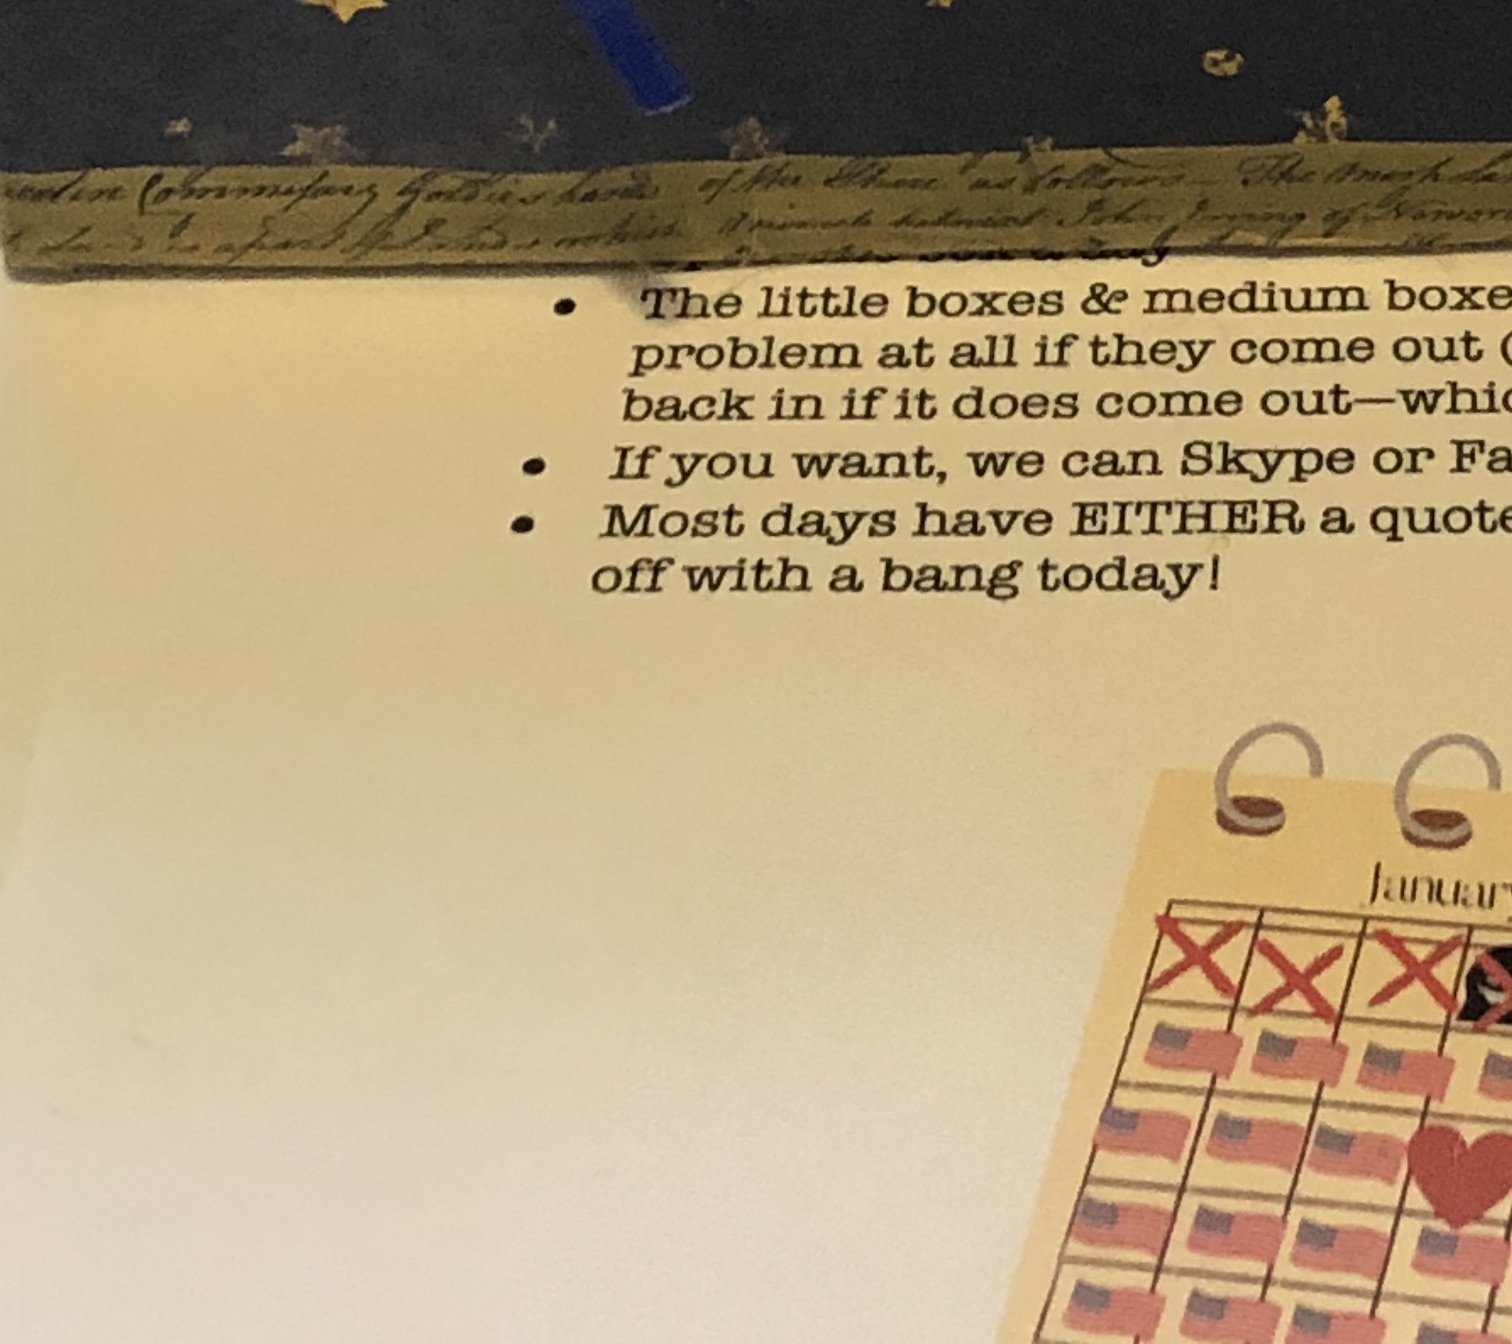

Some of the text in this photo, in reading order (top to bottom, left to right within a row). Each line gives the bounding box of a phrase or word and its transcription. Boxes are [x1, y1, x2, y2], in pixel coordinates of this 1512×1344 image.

[639, 285, 743, 320] The
[756, 285, 890, 319] little
[905, 285, 1065, 319] boxes
[1080, 282, 1129, 316] &
[1142, 280, 1371, 315] medium
[627, 334, 863, 378] problem
[877, 336, 936, 370] at
[949, 333, 1019, 369] all
[1033, 332, 1080, 368] if
[1088, 332, 1217, 374] they
[1230, 336, 1375, 365] come
[1392, 329, 1485, 364] out
[621, 387, 756, 422] back
[767, 387, 826, 421] in
[839, 386, 884, 421] if
[893, 387, 938, 421] it
[952, 385, 1080, 420] does
[1095, 389, 1244, 419] come
[608, 444, 663, 480] If
[663, 451, 775, 489] you
[790, 445, 948, 485] want,
[965, 450, 1045, 478] we
[1061, 449, 1164, 478] can
[1180, 439, 1356, 484] Skype
[1372, 446, 1436, 475] or
[598, 503, 746, 539] Most
[761, 502, 897, 547] days
[911, 501, 1054, 538] have
[1069, 498, 1307, 537] EITHER
[1319, 506, 1356, 535] a
[591, 553, 1220, 602] off with a bang today!
